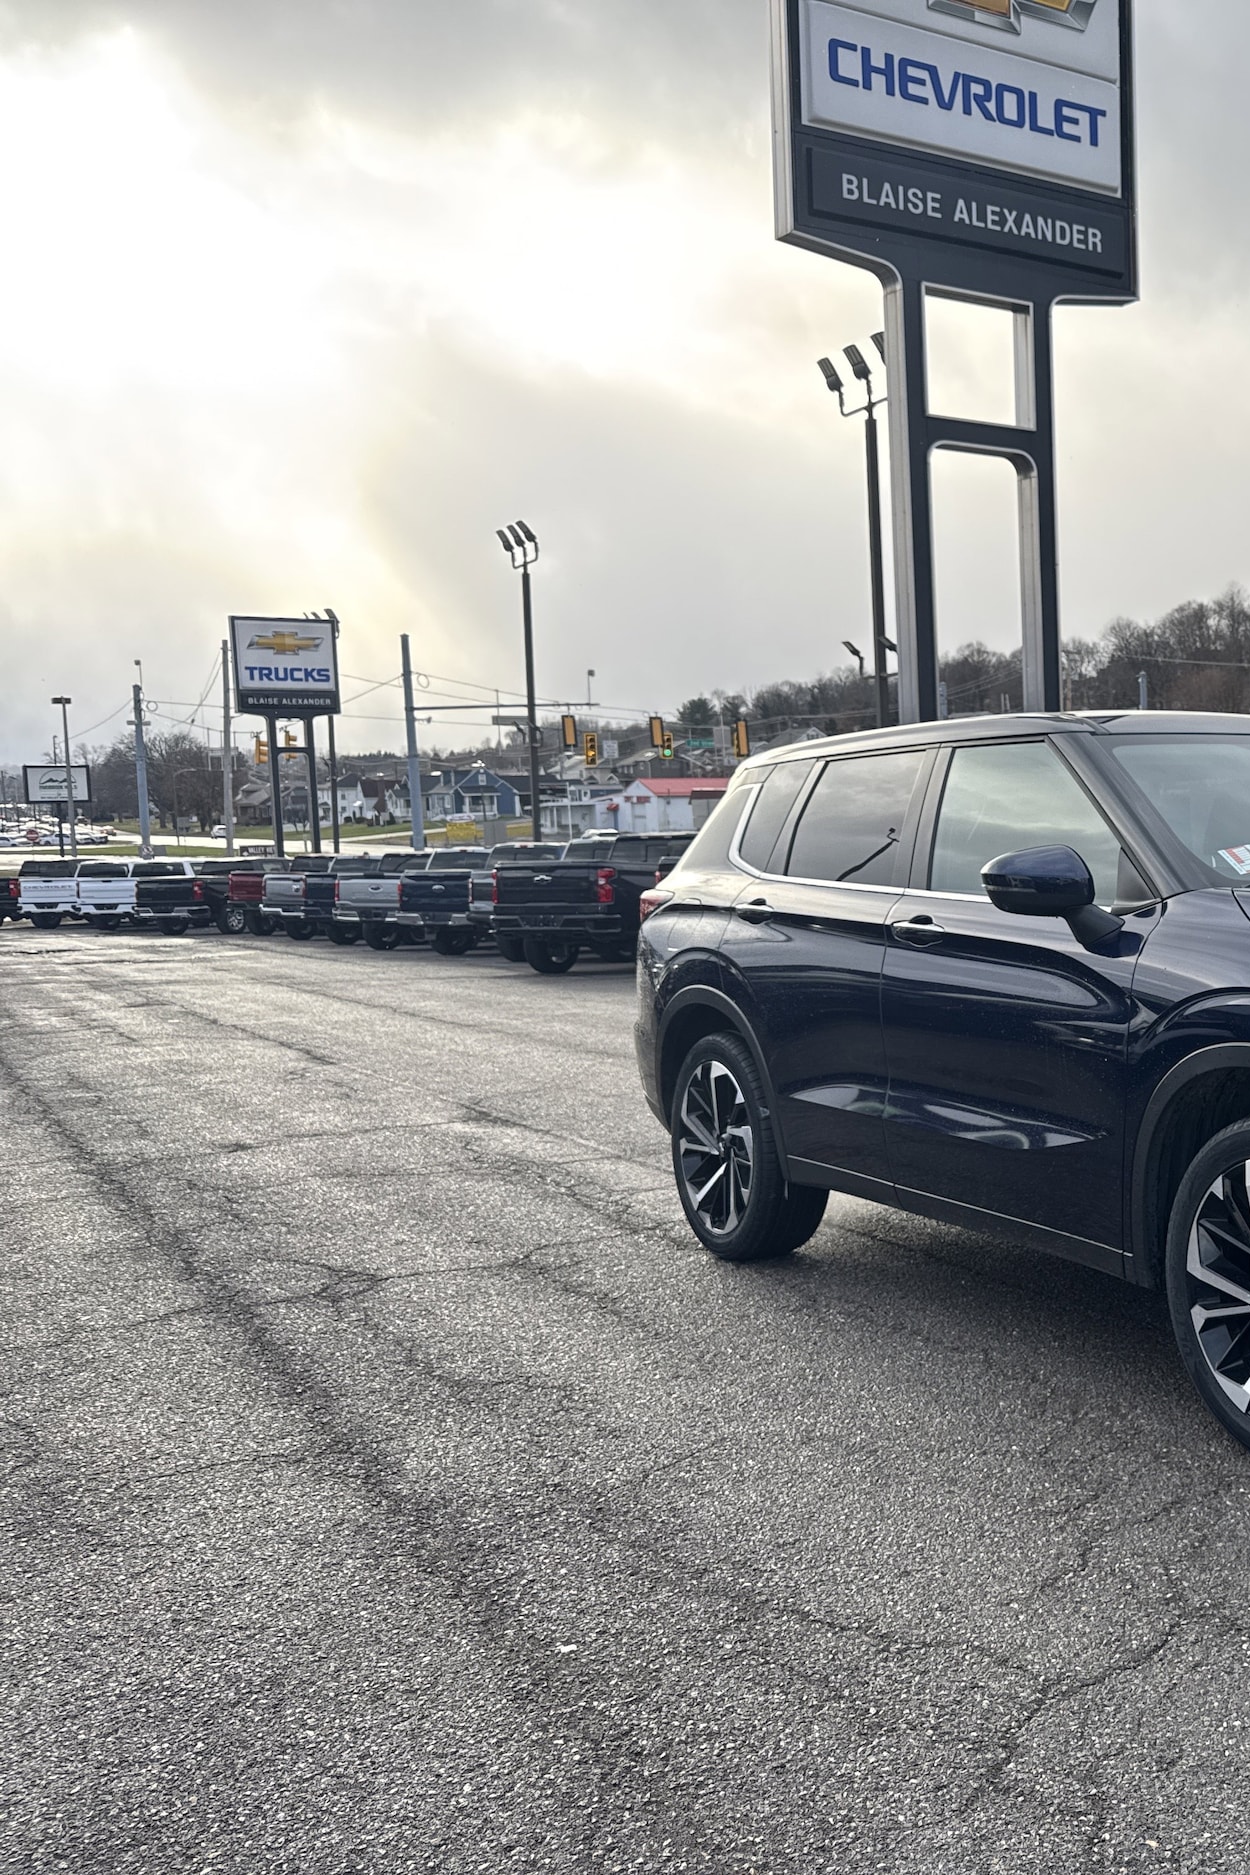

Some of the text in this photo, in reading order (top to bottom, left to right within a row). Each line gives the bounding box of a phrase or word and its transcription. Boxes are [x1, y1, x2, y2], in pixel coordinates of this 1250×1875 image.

[827, 37, 1107, 148] CHEVROLET
[841, 172, 1103, 253] BLAISE ALEXANDER
[244, 666, 331, 682] TRUCKS
[247, 697, 331, 705] BLAISE ALEXANDER
